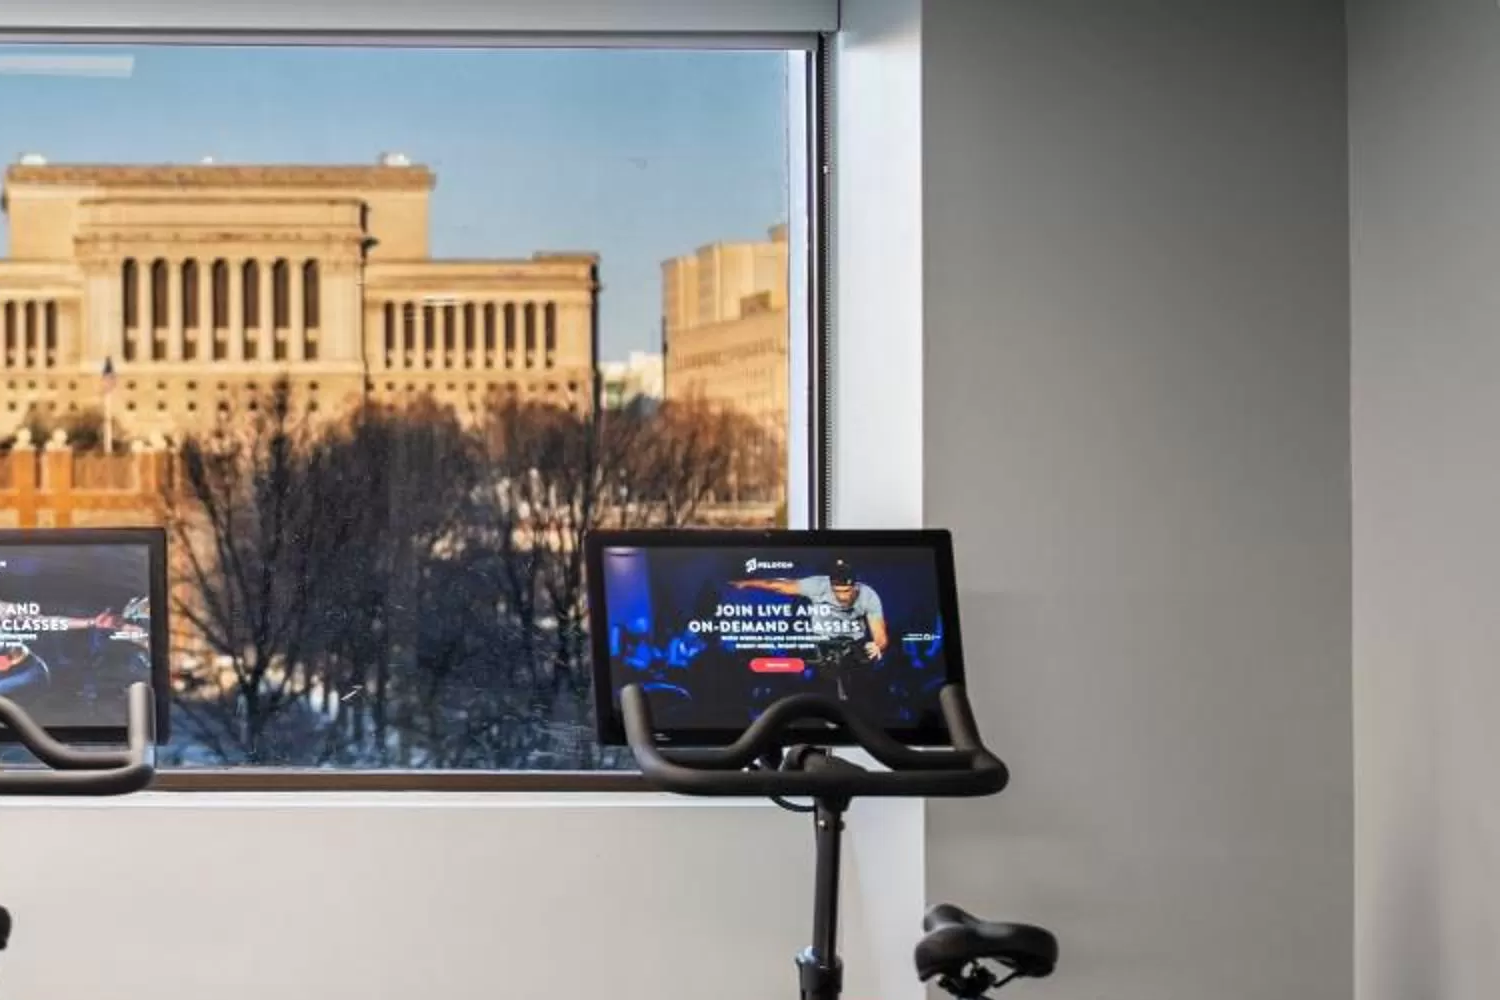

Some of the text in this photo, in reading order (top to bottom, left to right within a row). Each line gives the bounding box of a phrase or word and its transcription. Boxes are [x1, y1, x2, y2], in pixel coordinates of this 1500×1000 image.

[6, 603, 40, 615] AND
[715, 604, 831, 617] JOIN LIVE AND
[2, 619, 69, 631] CLASSES
[688, 621, 861, 633] ON-DEMAND CLASSES
